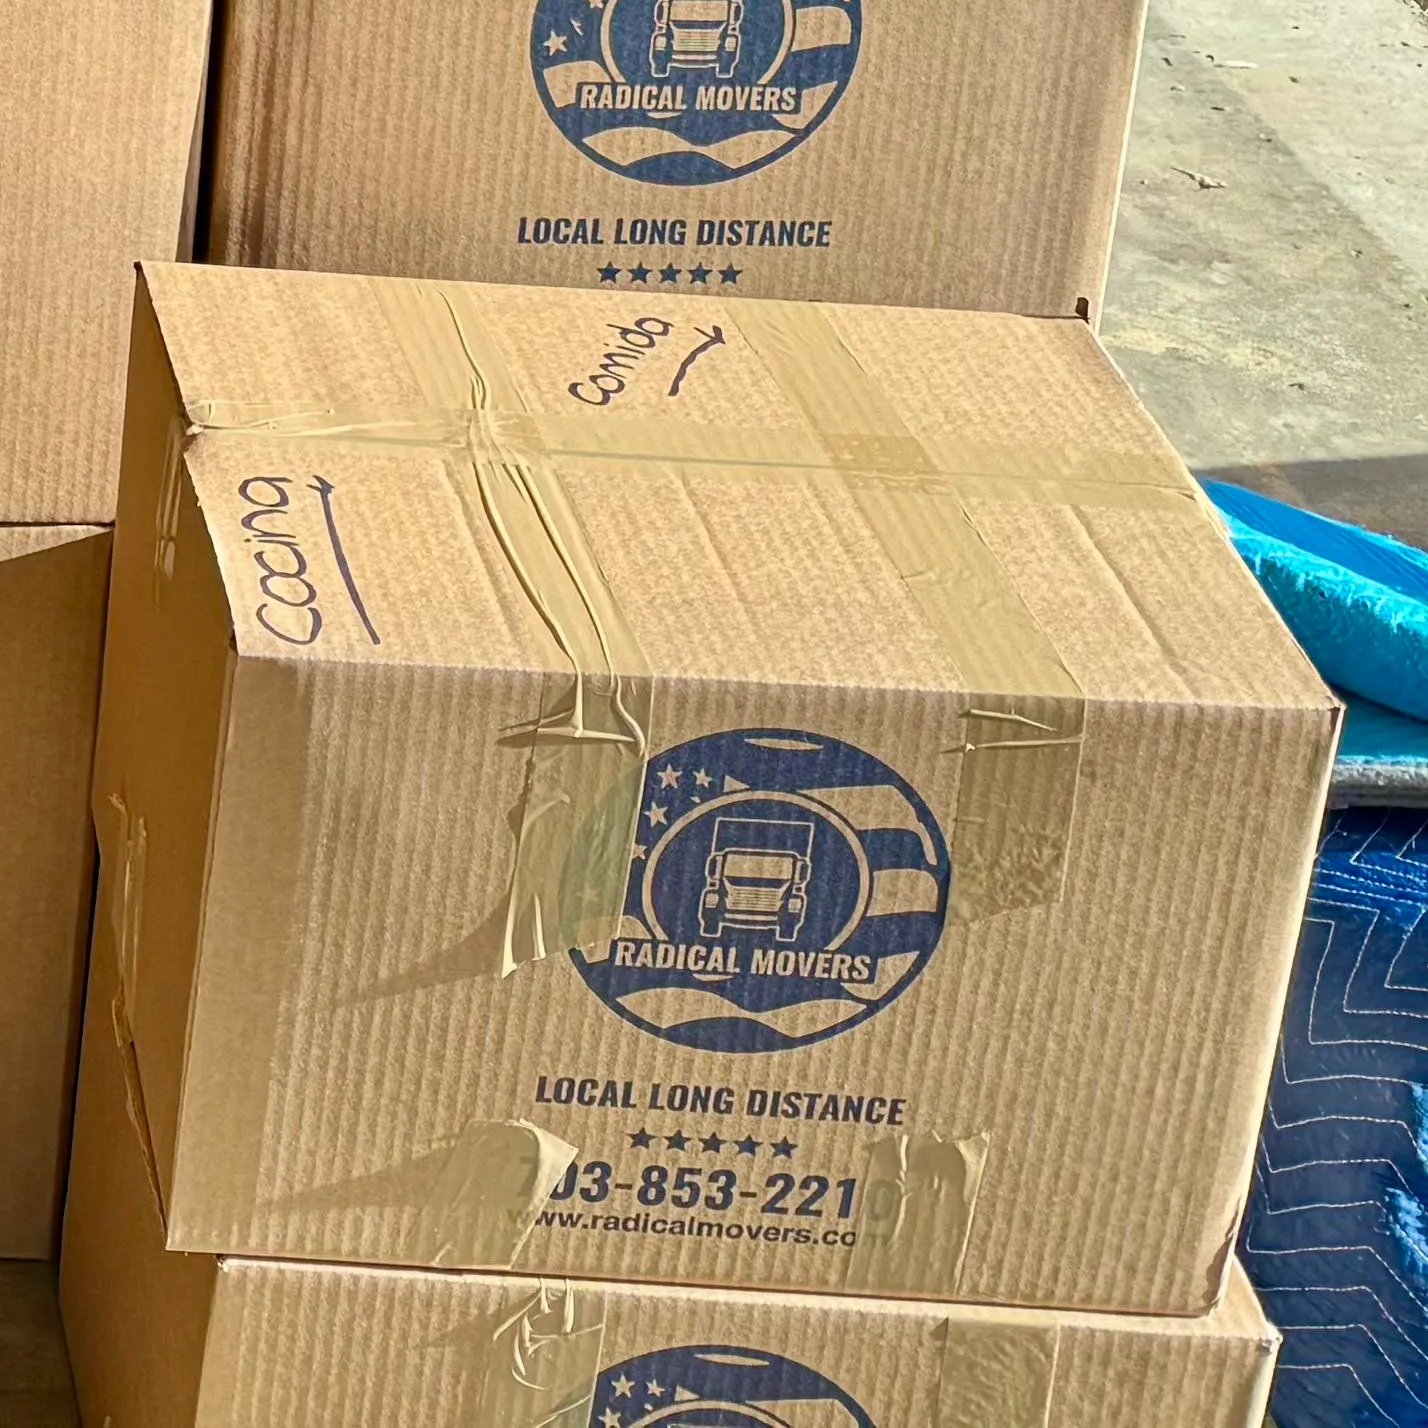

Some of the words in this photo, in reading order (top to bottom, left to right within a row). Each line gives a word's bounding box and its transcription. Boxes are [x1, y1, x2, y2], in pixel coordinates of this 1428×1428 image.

[580, 83, 687, 111] RADICAL
[695, 85, 797, 113] MOVERS
[518, 217, 603, 244] LOCAL
[614, 218, 686, 246] LONG
[697, 219, 832, 248] DISTANCE
[615, 941, 741, 975] RADICAL
[750, 947, 871, 981] MOVERS
[535, 1076, 637, 1109] LOCAL
[649, 1084, 735, 1115] LONG
[746, 1089, 907, 1127] DISTANCE
